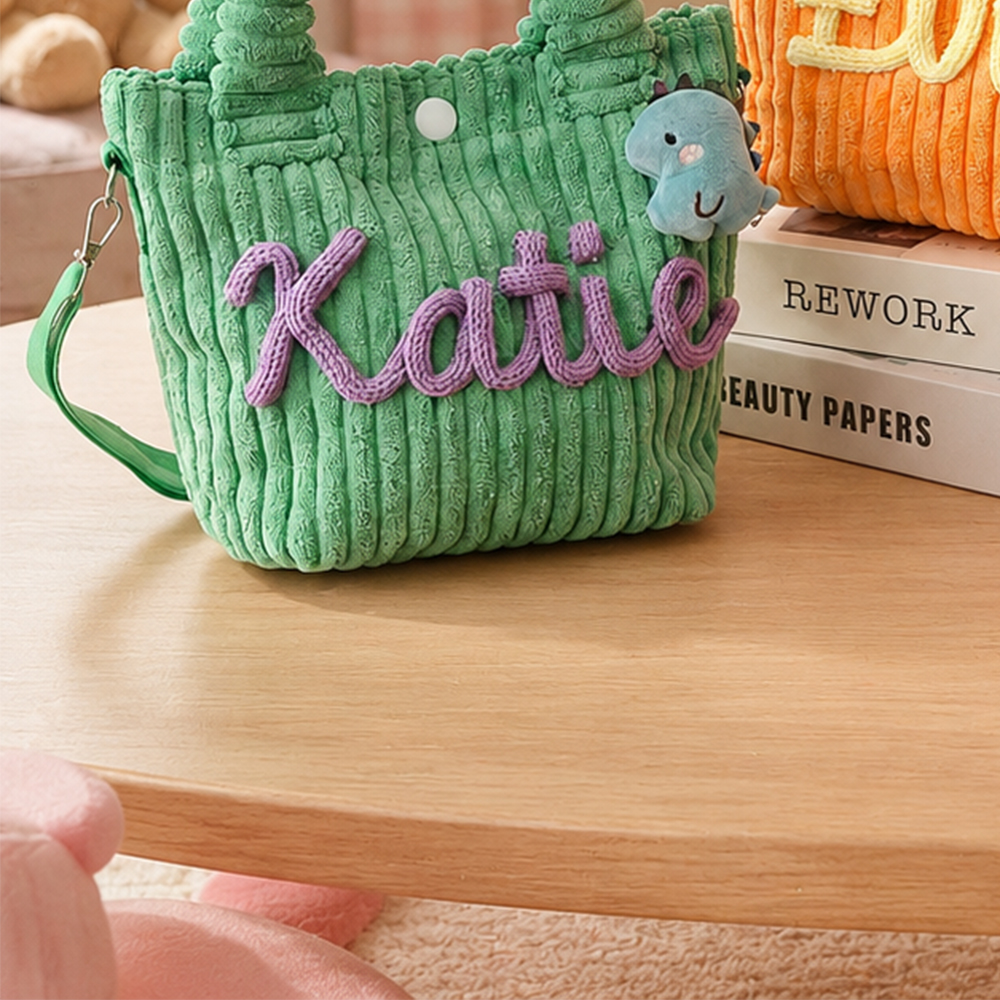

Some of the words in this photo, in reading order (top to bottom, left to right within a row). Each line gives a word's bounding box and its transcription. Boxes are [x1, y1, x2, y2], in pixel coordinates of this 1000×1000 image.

[224, 219, 740, 408] Katie
[783, 279, 976, 336] REWORK
[823, 396, 933, 448] PAPERS
